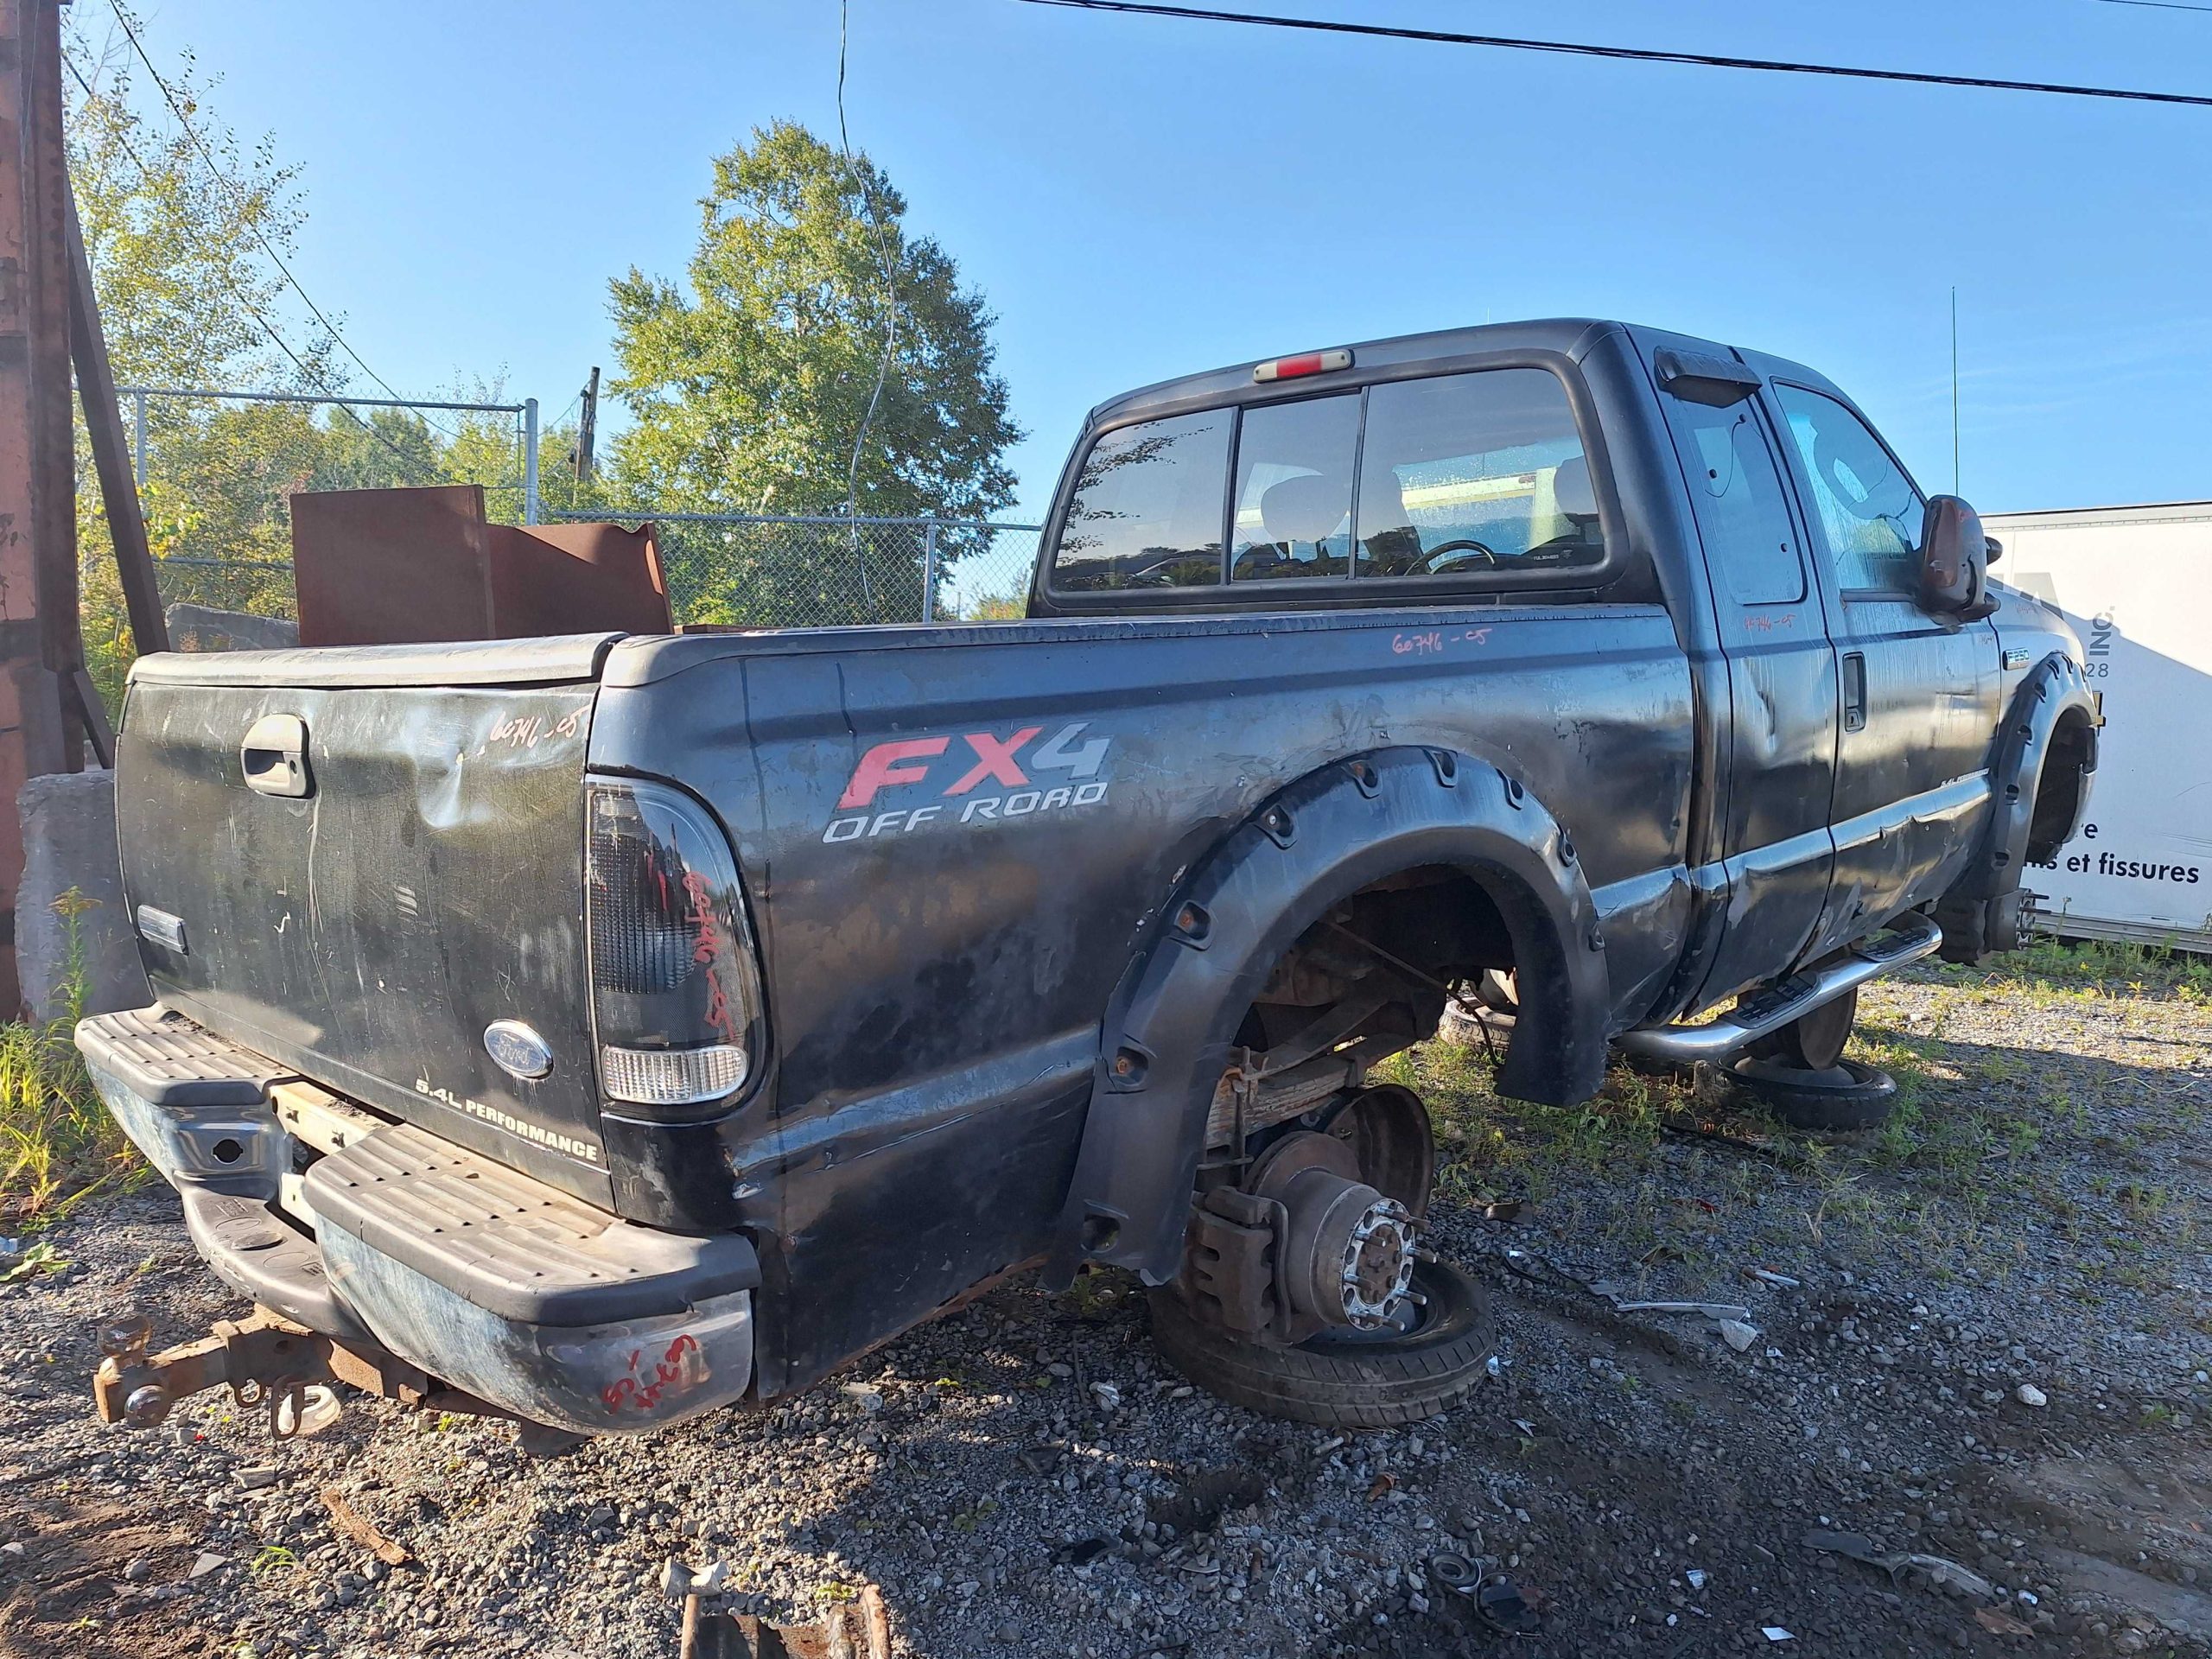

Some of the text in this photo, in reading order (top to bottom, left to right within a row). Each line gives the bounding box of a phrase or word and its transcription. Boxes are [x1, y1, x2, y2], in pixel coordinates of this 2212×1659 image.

[2088, 606, 2115, 656] INC.
[836, 721, 1116, 810] FX4
[822, 782, 1109, 843] OFF ROAD
[2066, 854, 2091, 873] et
[2099, 852, 2199, 884] fissures
[416, 1078, 598, 1162] 5.4L PERFORMANCE
